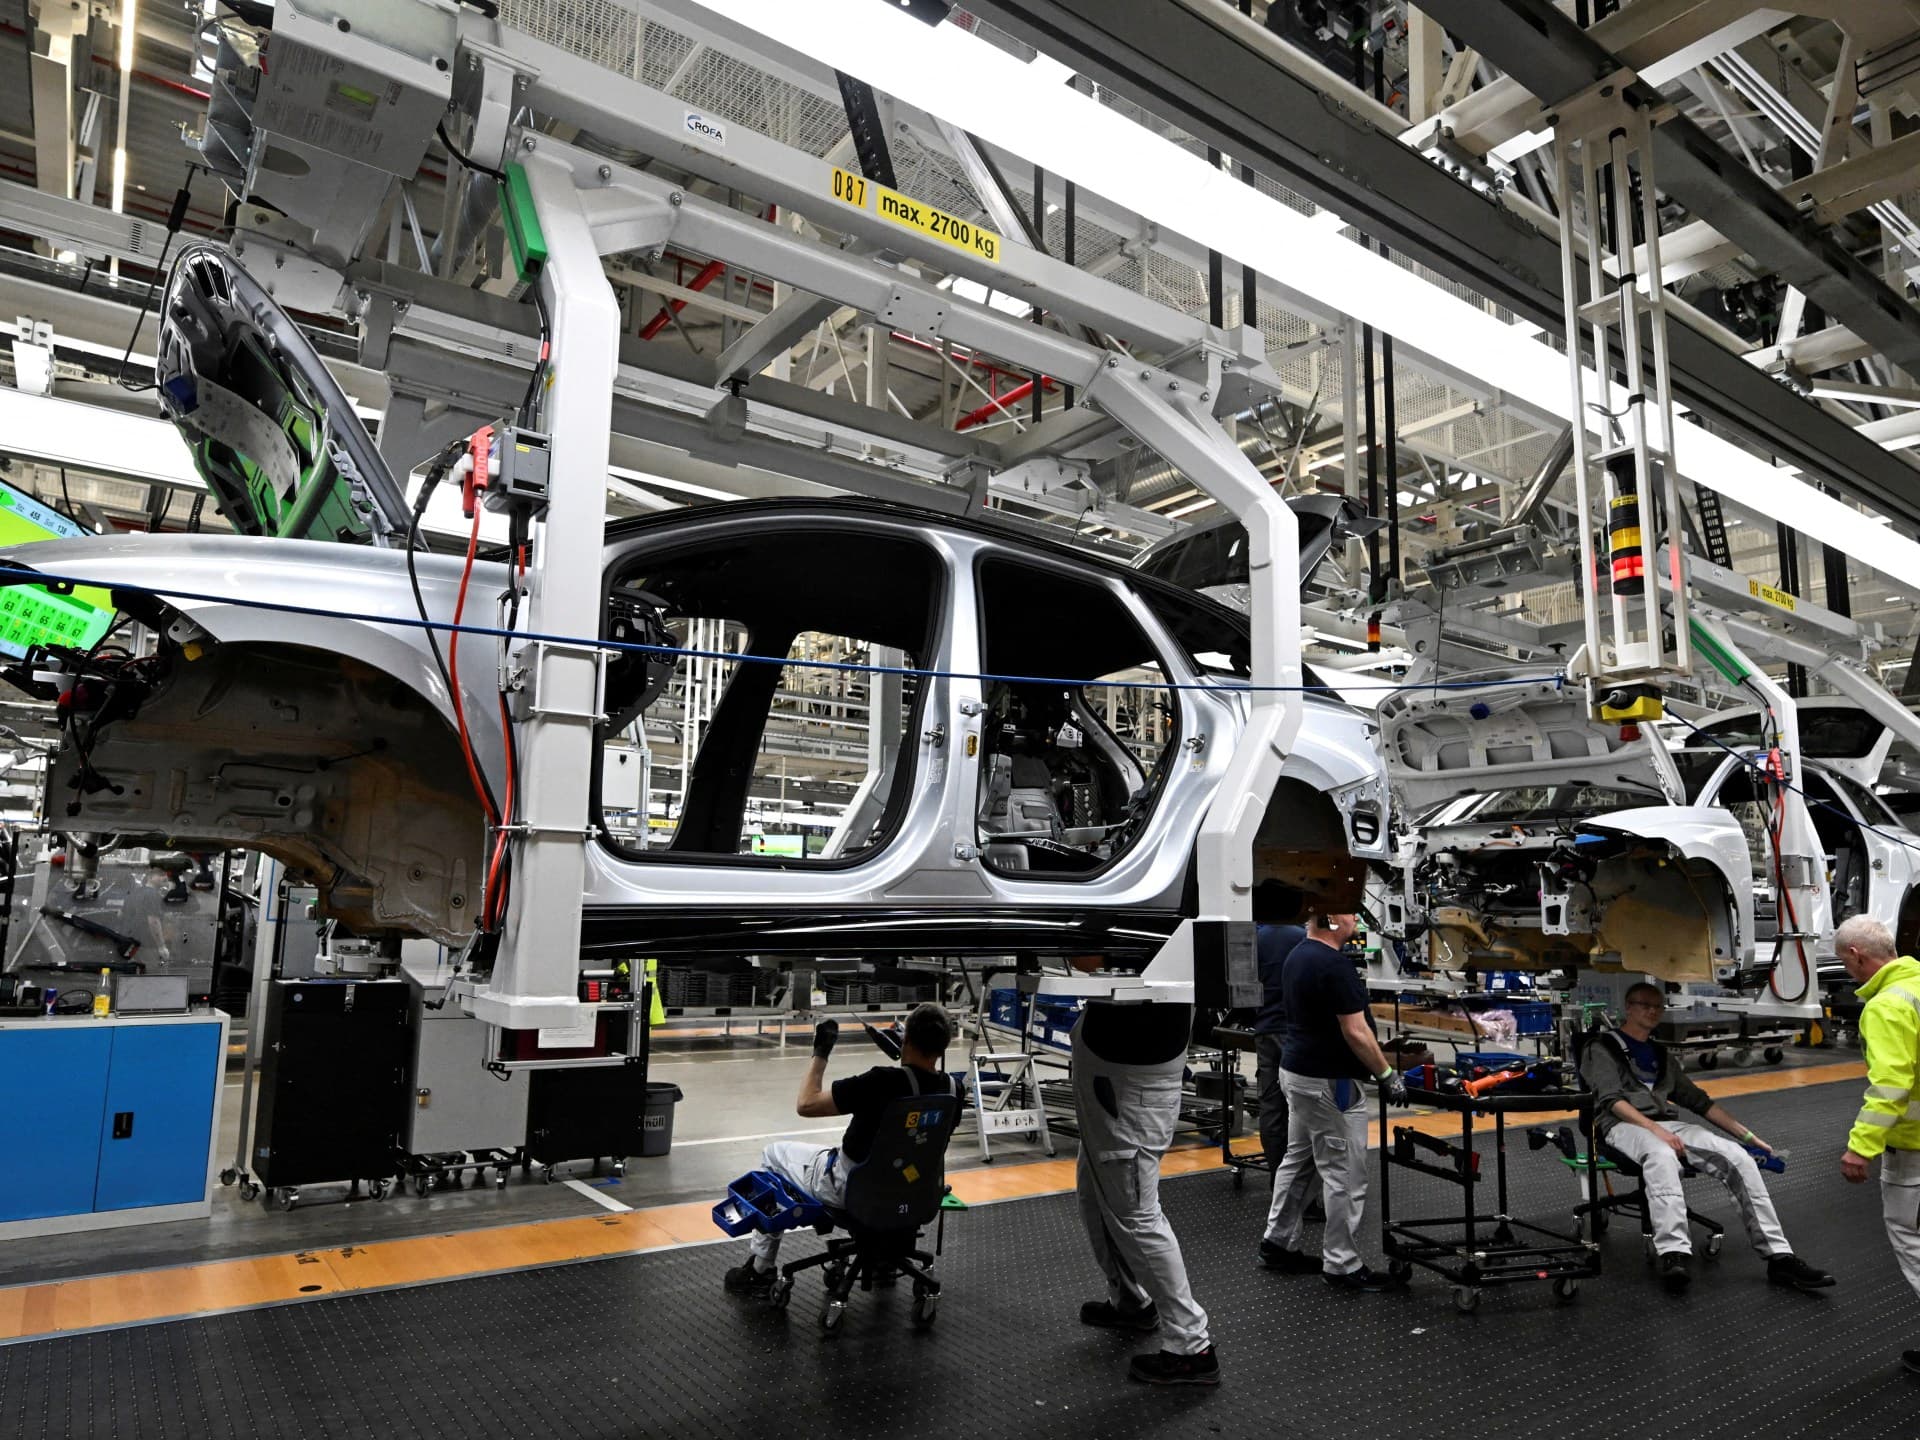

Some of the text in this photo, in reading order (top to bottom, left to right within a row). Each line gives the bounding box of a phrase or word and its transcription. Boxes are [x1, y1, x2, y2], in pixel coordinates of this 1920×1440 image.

[695, 121, 723, 139] ROFA
[834, 170, 994, 259] 087 max. 2700 kg
[4, 601, 15, 611] 63
[23, 608, 33, 618] 64
[11, 630, 21, 640] 71
[899, 1204, 909, 1213] 21
